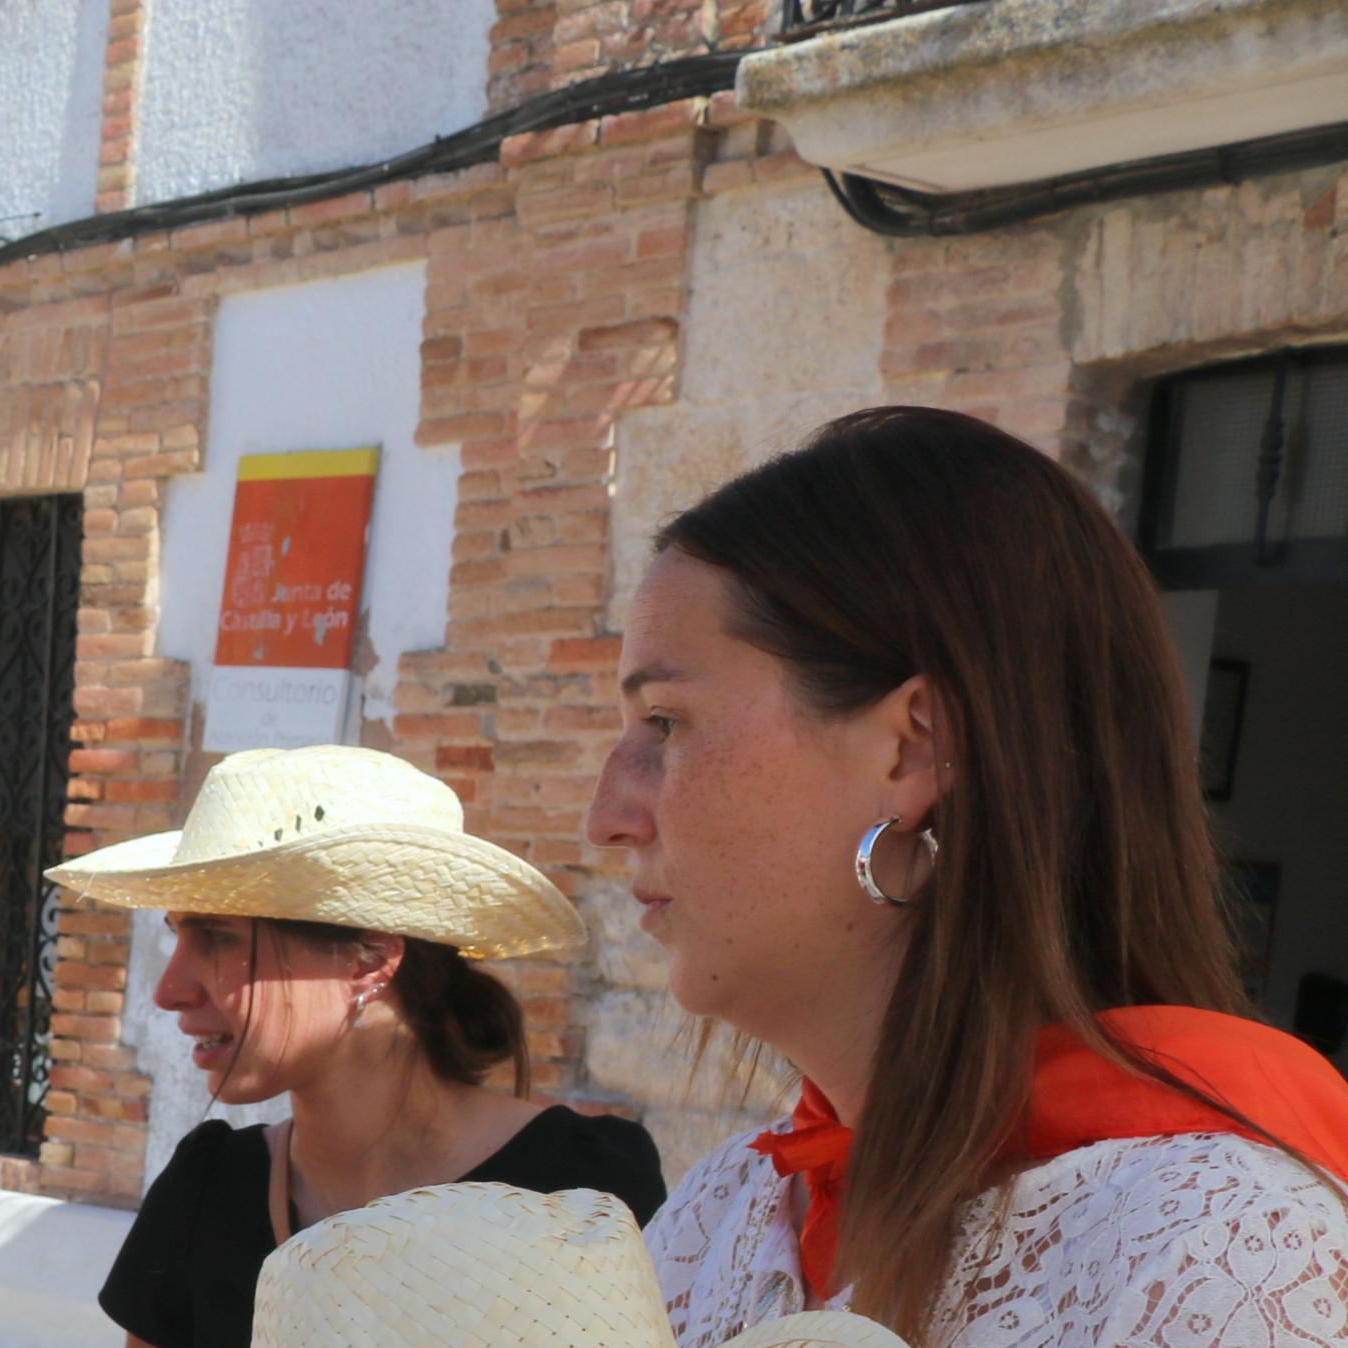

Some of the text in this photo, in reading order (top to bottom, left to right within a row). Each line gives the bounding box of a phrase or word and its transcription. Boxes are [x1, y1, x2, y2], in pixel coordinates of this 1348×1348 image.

[270, 579, 352, 603] Junta de
[282, 612, 298, 636] y
[213, 675, 337, 705] Consultorio
